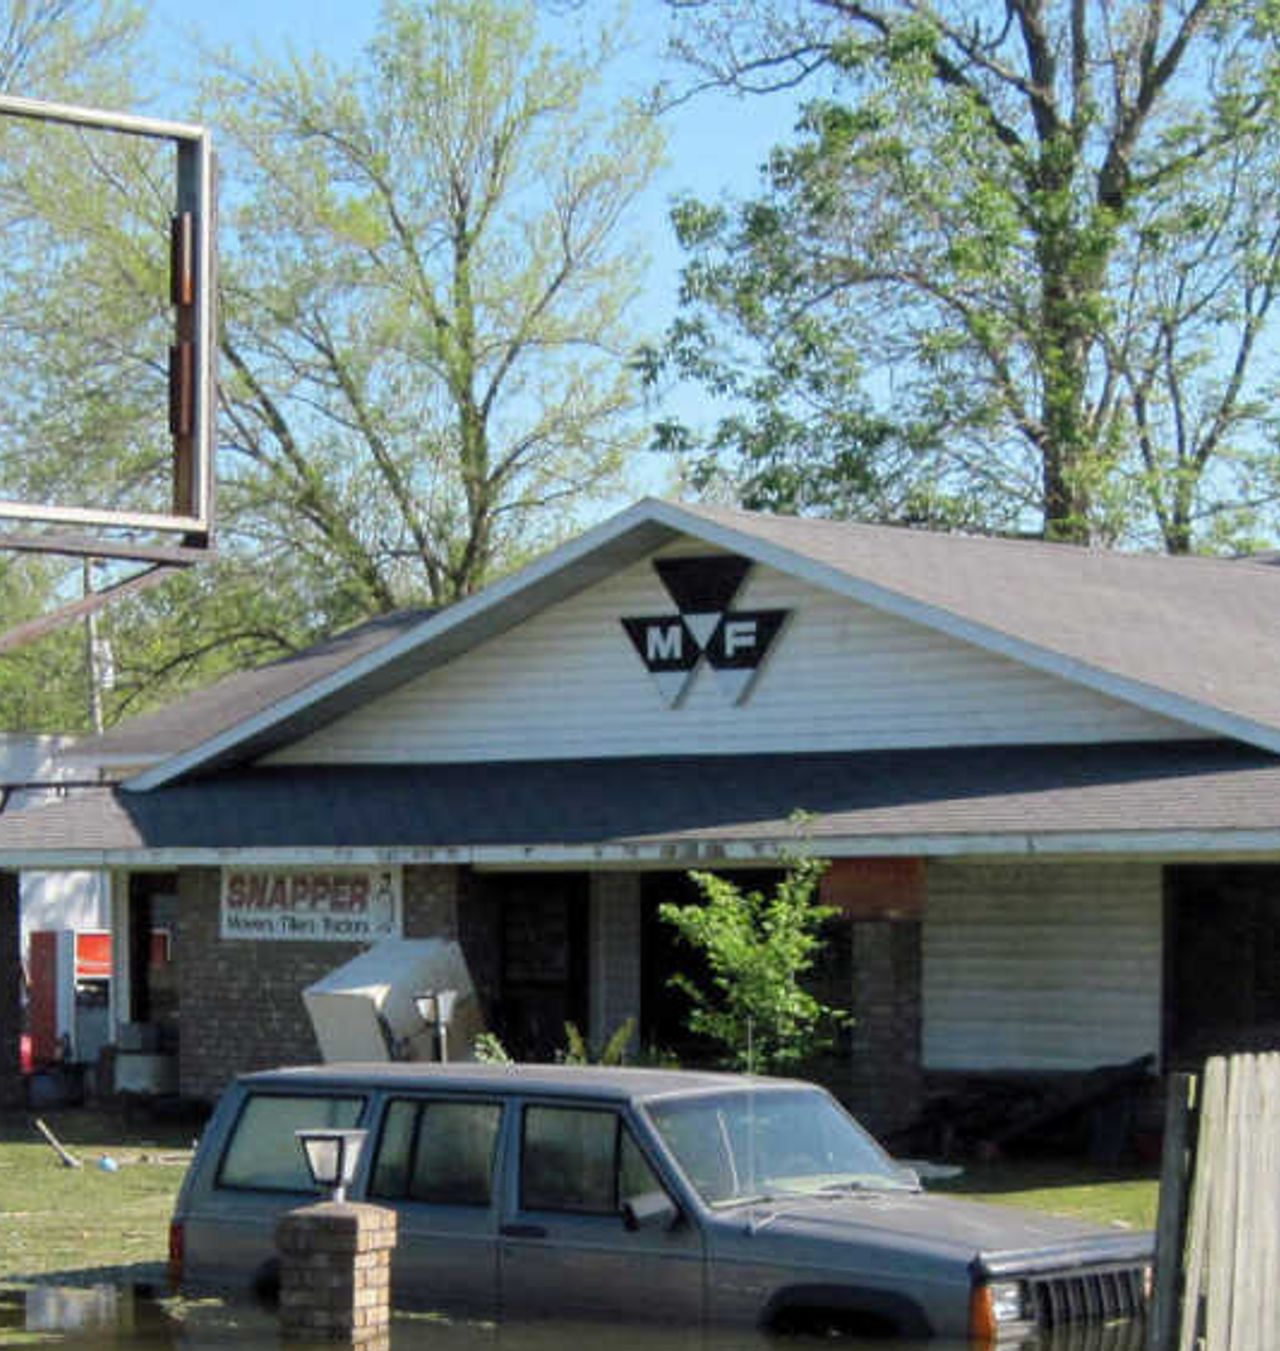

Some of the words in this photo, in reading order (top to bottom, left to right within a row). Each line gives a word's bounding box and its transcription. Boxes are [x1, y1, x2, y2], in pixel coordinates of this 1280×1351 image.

[646, 626, 682, 660] M
[725, 622, 757, 658] F
[228, 872, 369, 911] SNAPPER
